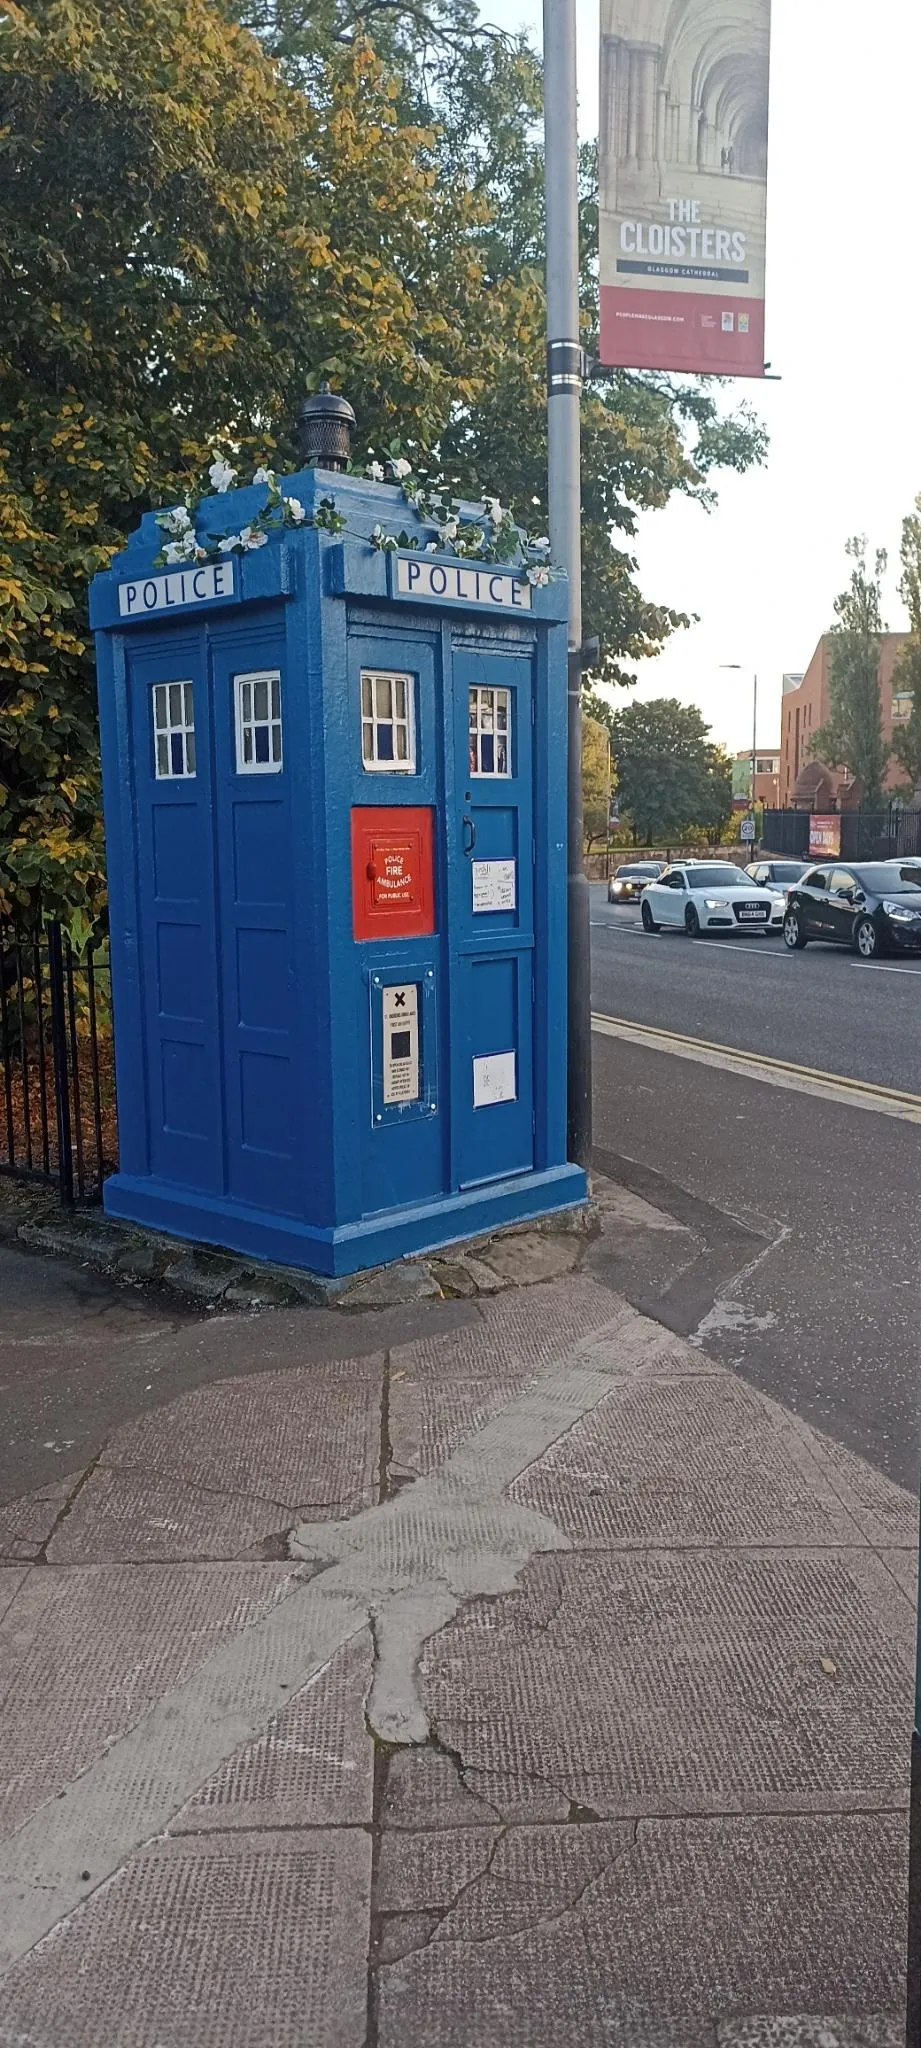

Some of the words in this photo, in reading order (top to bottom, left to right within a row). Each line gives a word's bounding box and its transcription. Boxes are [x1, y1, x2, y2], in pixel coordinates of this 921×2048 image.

[667, 198, 701, 223] THE
[620, 221, 746, 262] CLOISTERS
[647, 265, 680, 274] GLASGOW
[681, 268, 719, 278] CATHEDRAL
[126, 566, 224, 613] POLICE
[407, 561, 522, 605] POLICE
[384, 855, 404, 865] POLICE
[376, 873, 412, 889] AMBULANCE
[385, 866, 403, 876] FIRE
